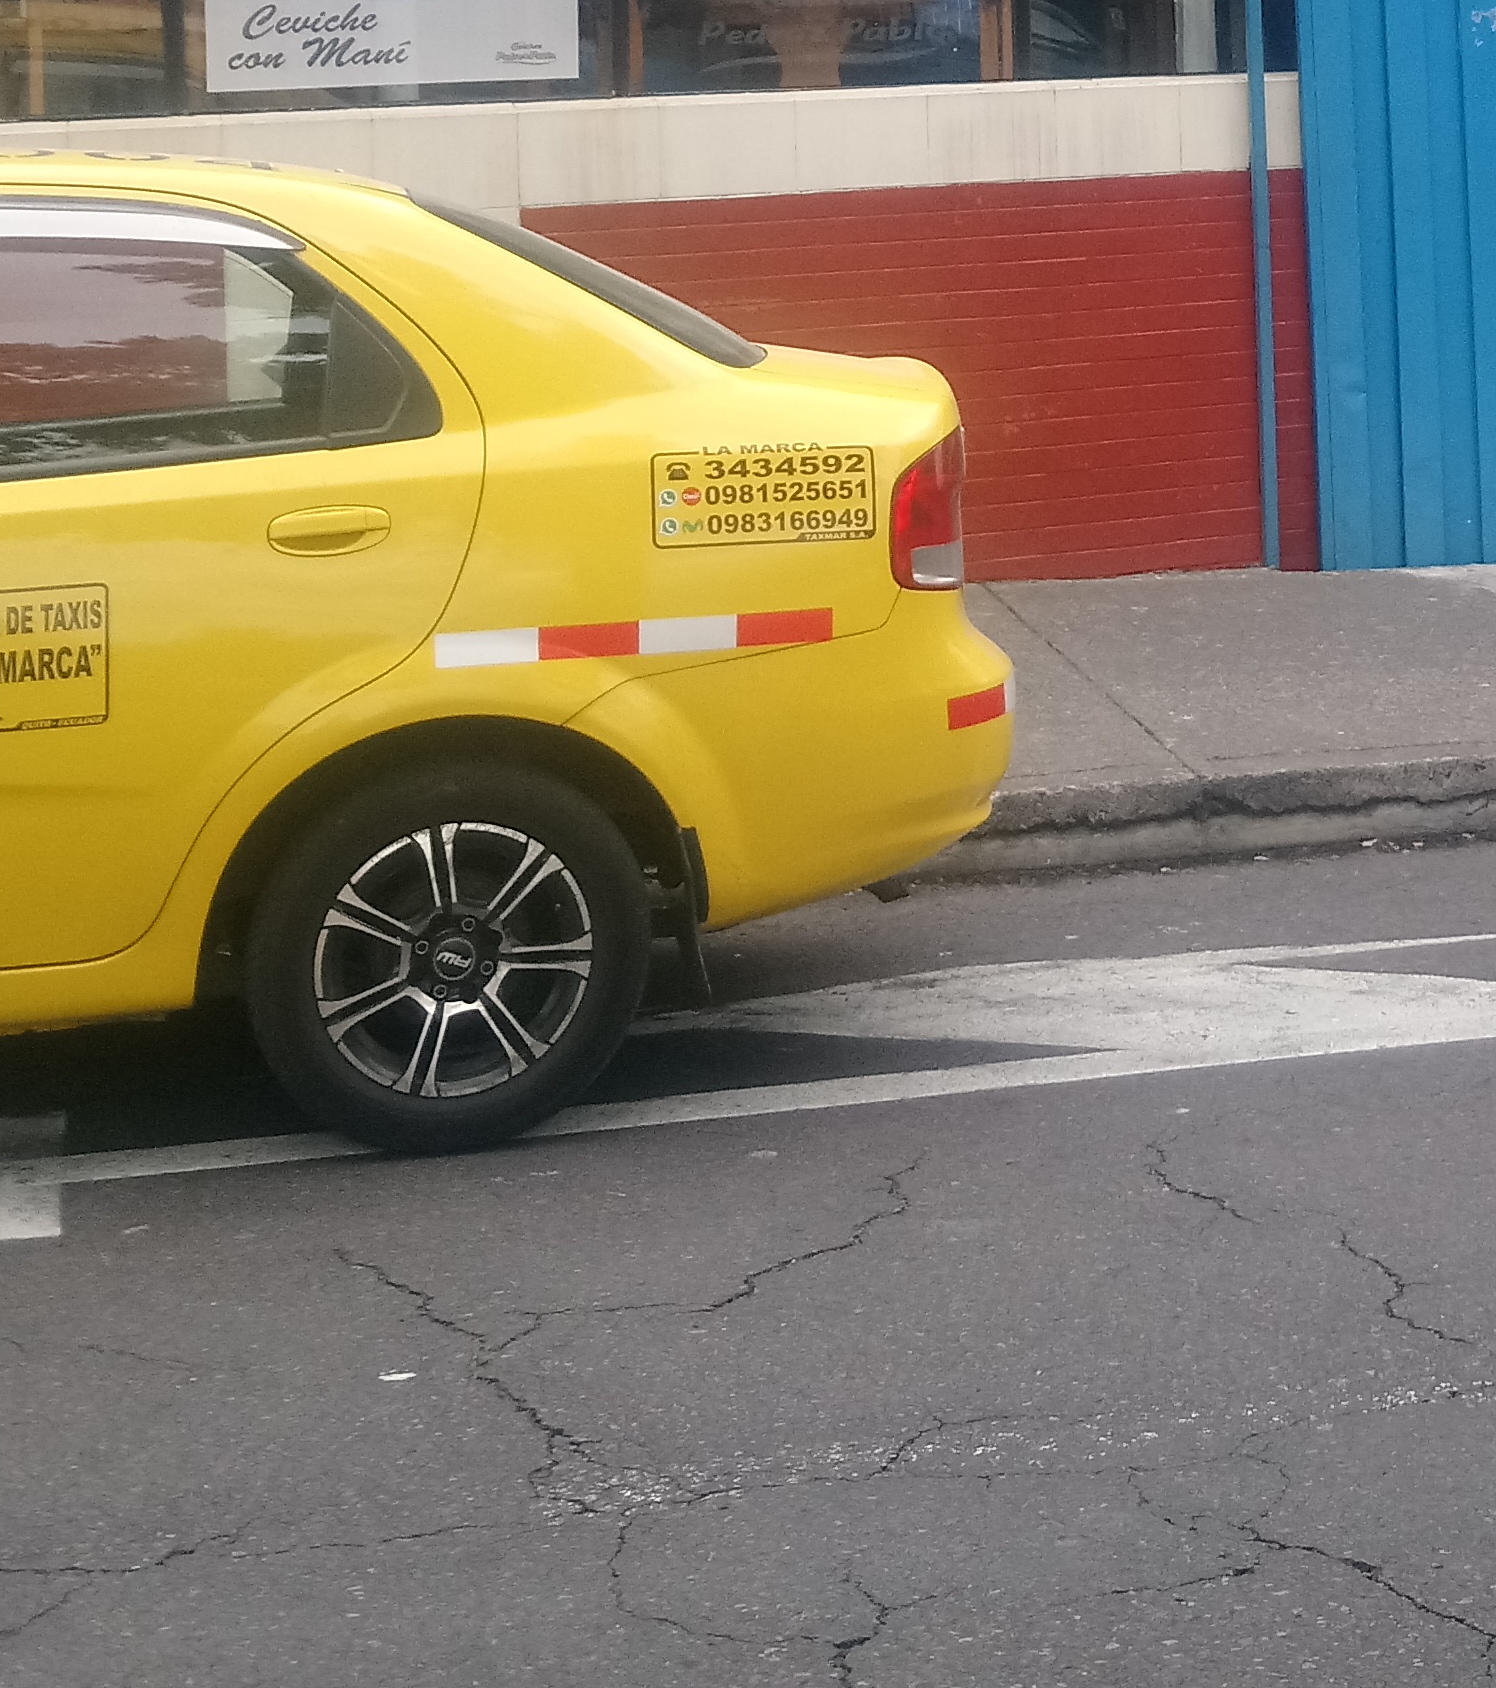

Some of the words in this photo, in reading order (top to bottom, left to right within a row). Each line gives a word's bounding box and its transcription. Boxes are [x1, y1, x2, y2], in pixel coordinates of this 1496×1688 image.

[241, 2, 379, 42] Ceviche
[227, 47, 287, 72] con
[301, 35, 412, 69] Maní
[702, 443, 733, 456] LA
[739, 441, 824, 454] MARCA
[704, 453, 866, 480] 3434592
[705, 478, 868, 506] 0981525651
[707, 507, 869, 535] 0983166949
[805, 533, 847, 542] TAXMAR
[5, 604, 34, 635] DE
[40, 599, 103, 633] TAXIS
